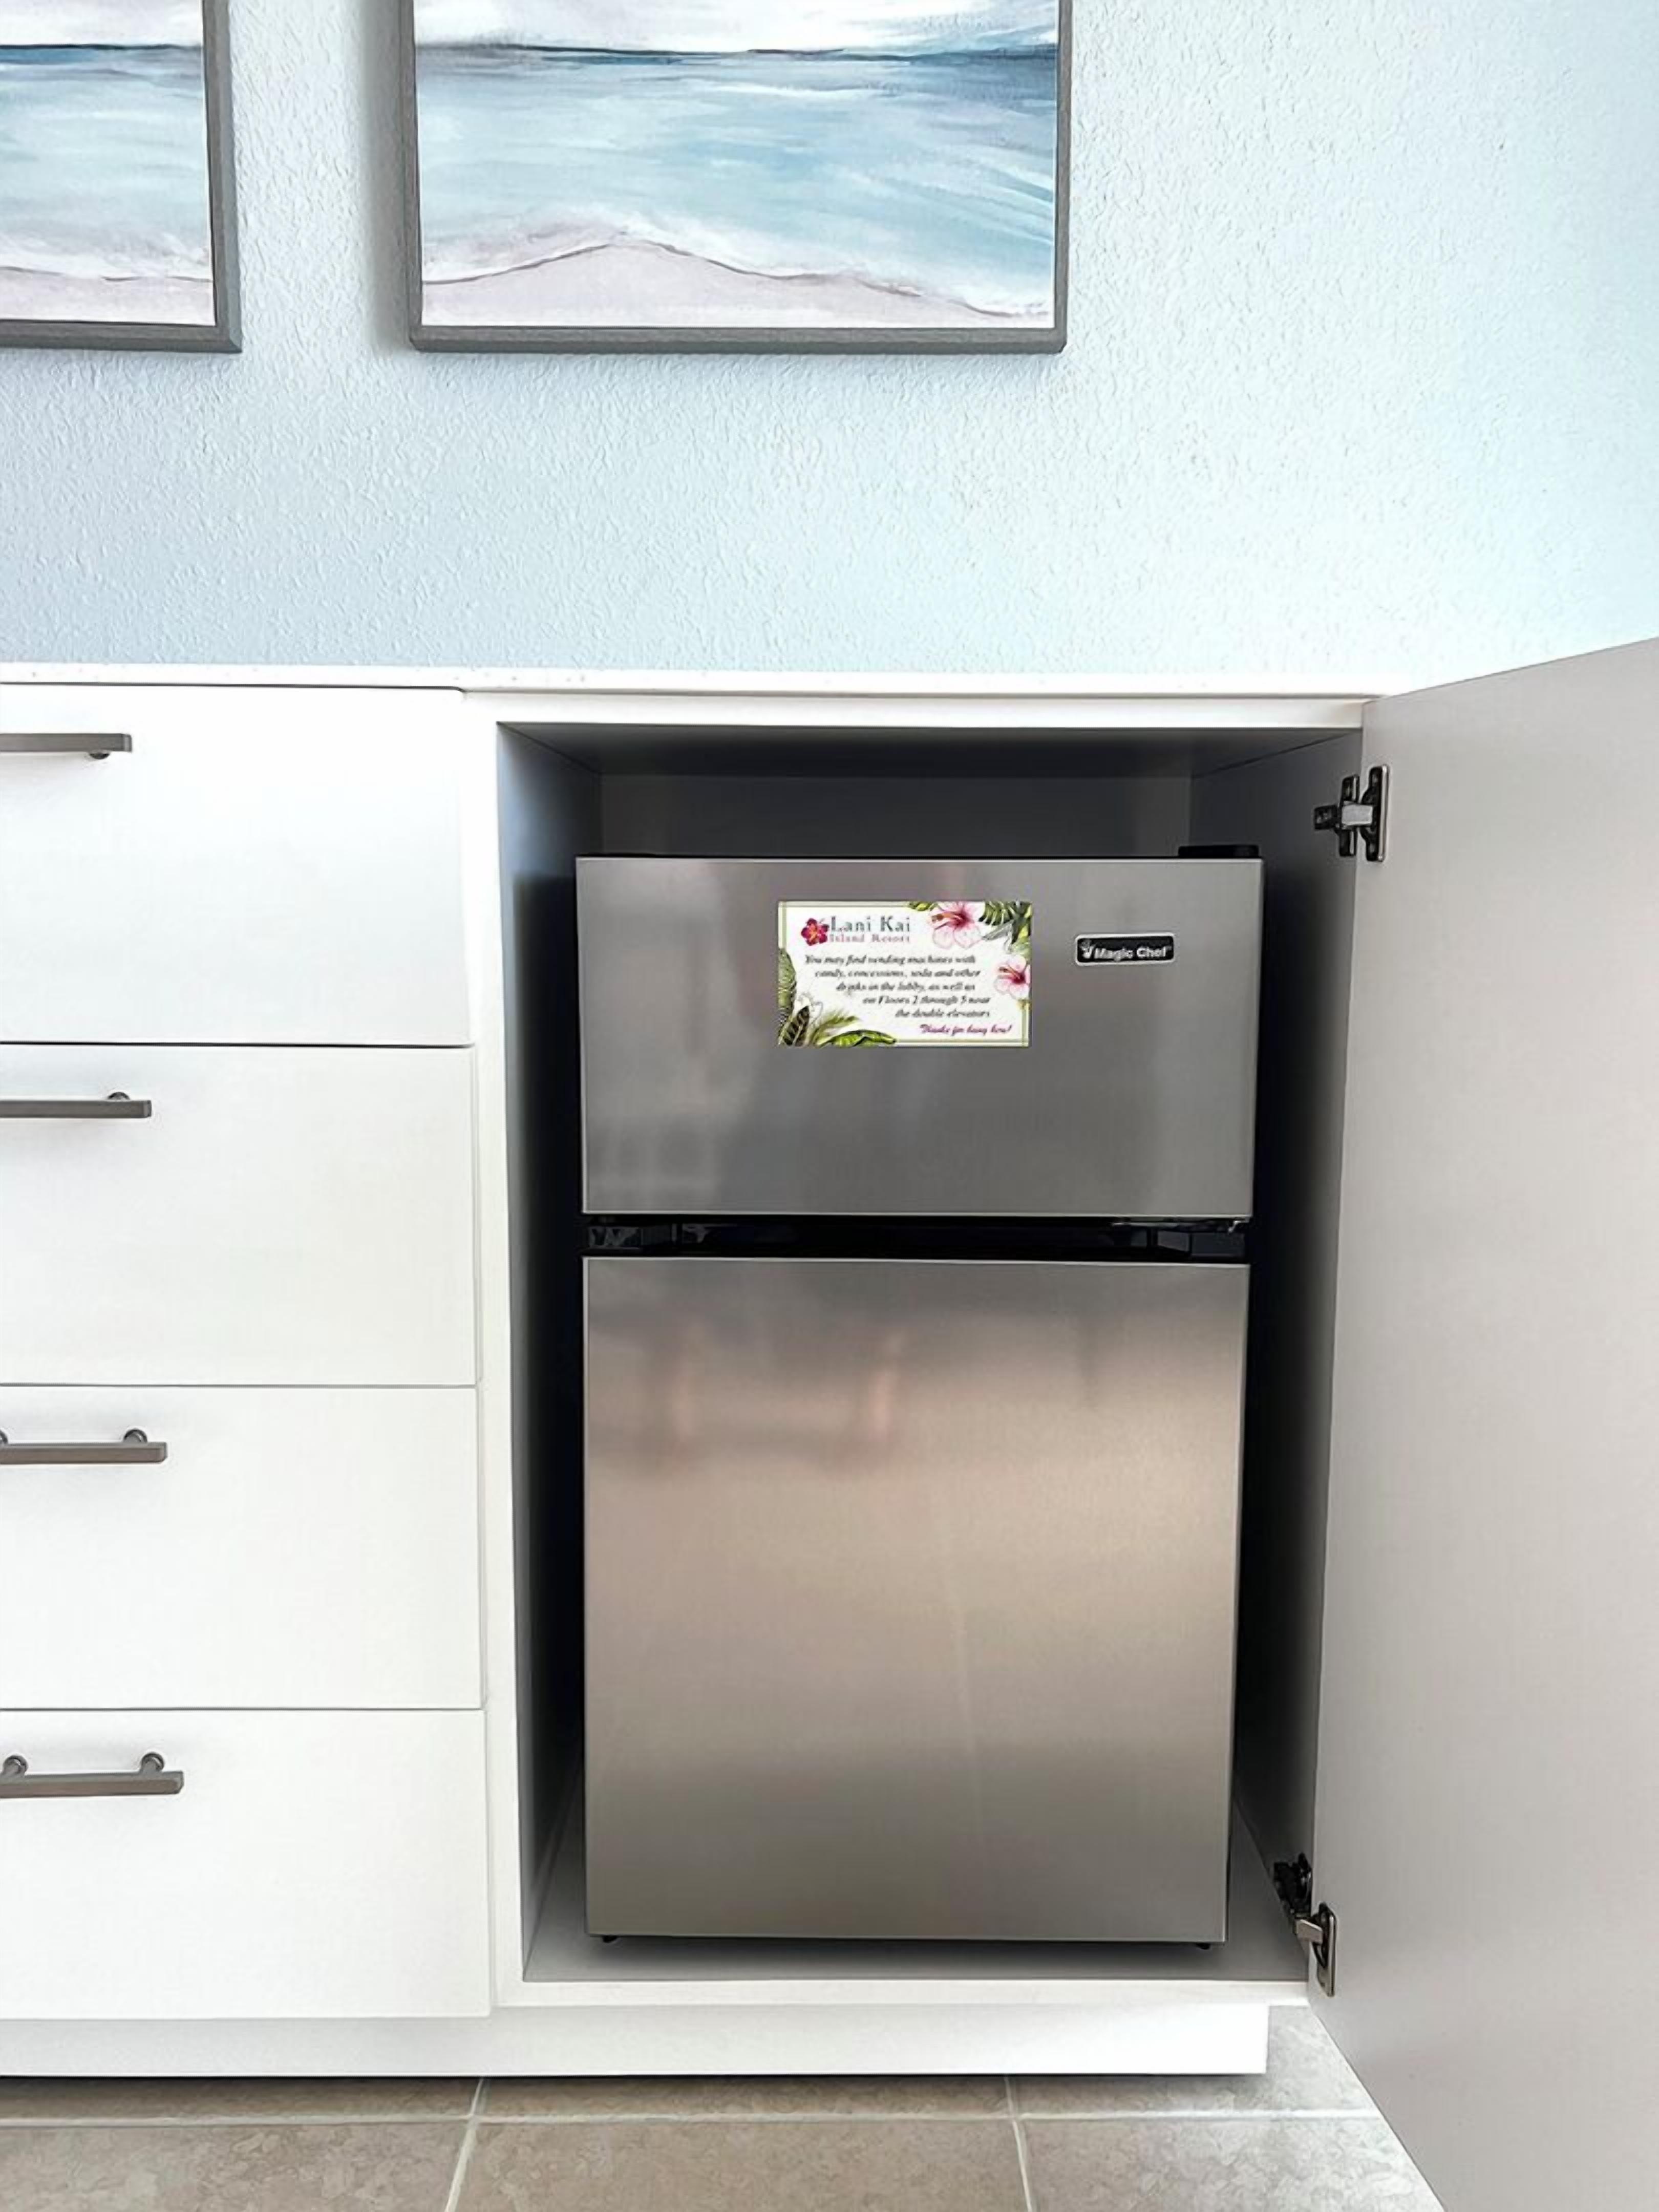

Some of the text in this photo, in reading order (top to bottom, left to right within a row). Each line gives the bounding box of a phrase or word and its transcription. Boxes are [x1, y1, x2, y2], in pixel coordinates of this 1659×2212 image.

[831, 916, 910, 932] Lani Kai
[829, 934, 910, 943] Island Resort
[1094, 946, 1168, 962] Magic Chef
[805, 954, 975, 966] You may find vending machines with
[911, 968, 932, 977] soda
[934, 968, 953, 977] and
[954, 968, 981, 977] other
[881, 982, 895, 991] the
[943, 982, 963, 991] well
[921, 995, 959, 1006] through
[896, 1008, 990, 1017] the double elevators
[920, 1024, 950, 1034] Thanks
[952, 1026, 964, 1036] for
